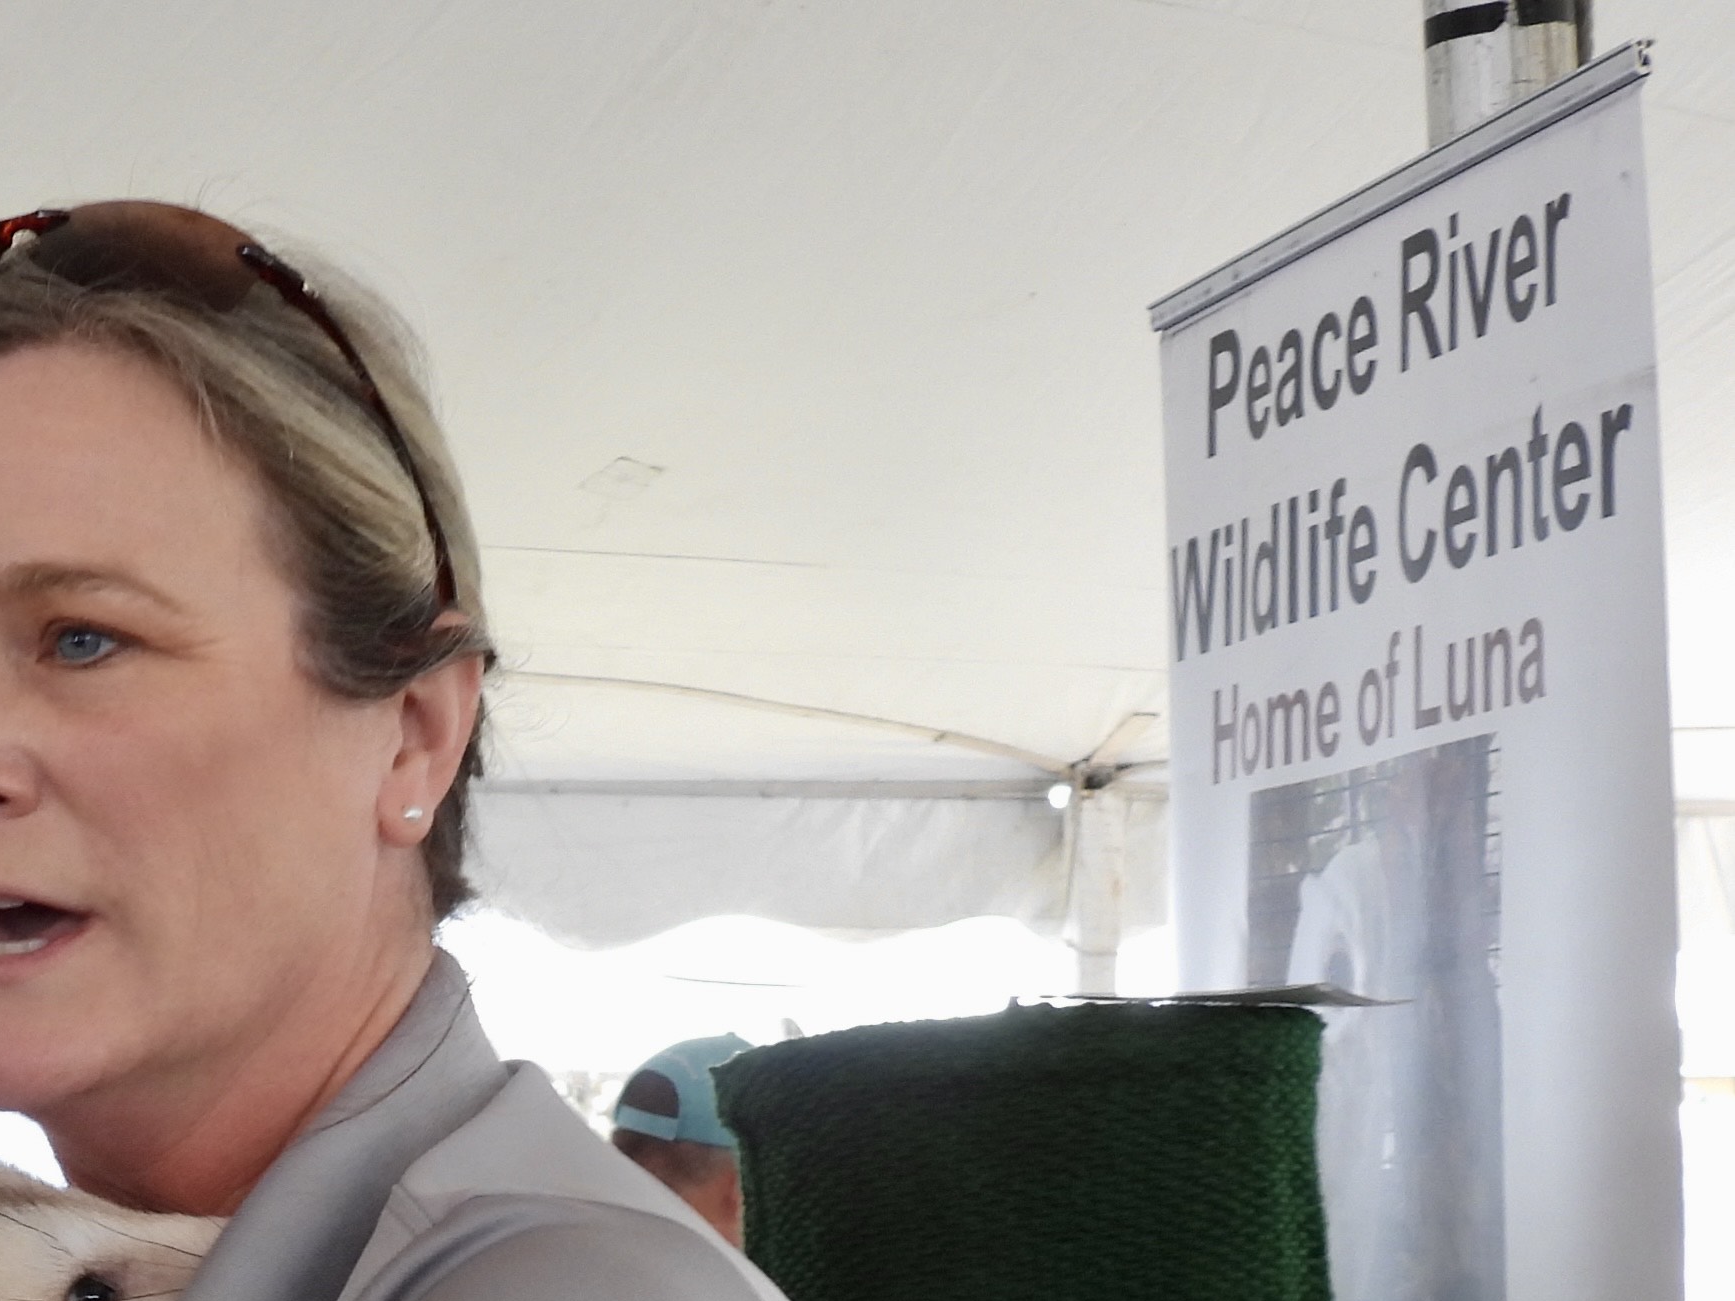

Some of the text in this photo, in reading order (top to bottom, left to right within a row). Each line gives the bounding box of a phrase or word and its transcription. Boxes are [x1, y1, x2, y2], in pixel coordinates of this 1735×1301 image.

[1206, 192, 1573, 459] Peace River
[1171, 403, 1634, 662] Wildlife Center
[1212, 615, 1547, 785] Home of Luna
